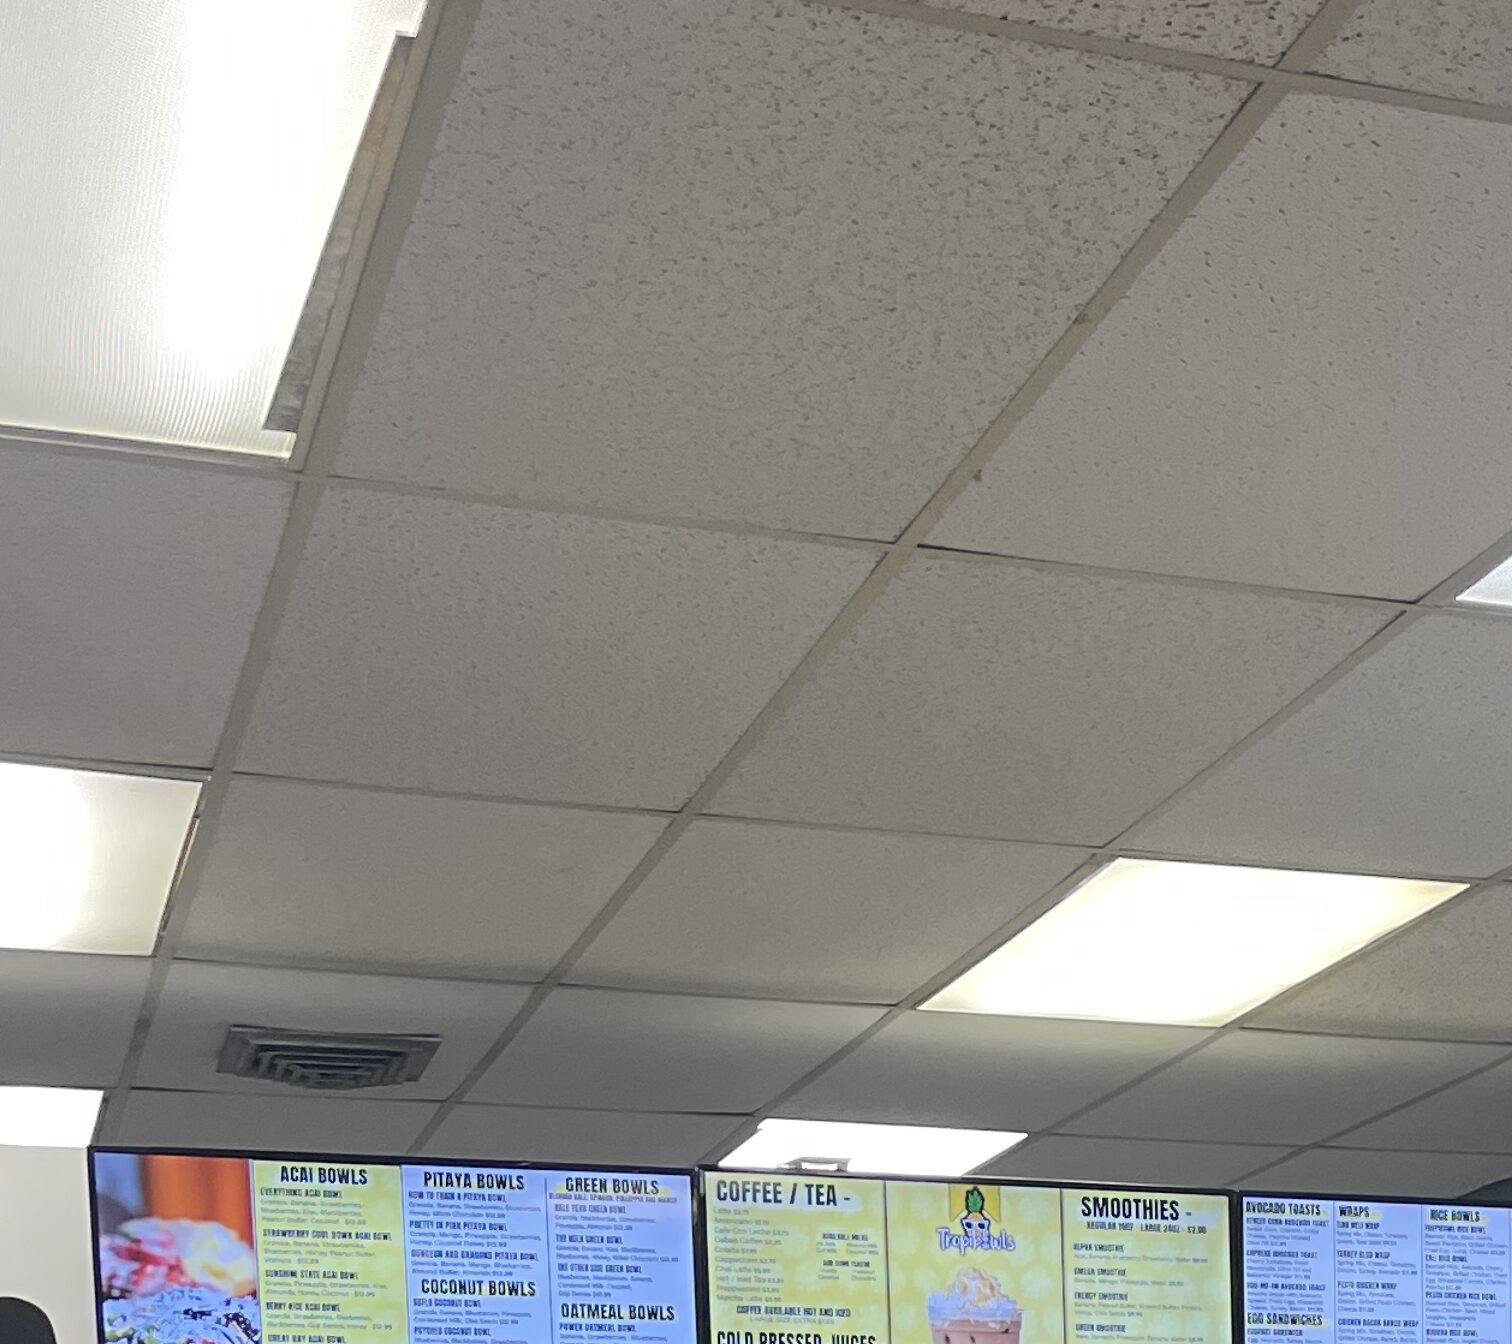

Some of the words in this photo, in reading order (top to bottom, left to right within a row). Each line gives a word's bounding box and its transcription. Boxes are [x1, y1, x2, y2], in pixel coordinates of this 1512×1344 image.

[281, 1166, 313, 1183] ACAI
[318, 1169, 368, 1185] BOWLS
[424, 1171, 472, 1188] PITAYA
[476, 1174, 524, 1190] BOWLS
[566, 1177, 607, 1193] GREEN
[612, 1179, 659, 1194] BOWLS
[717, 1180, 782, 1203] COFFEE
[789, 1183, 797, 1204] /
[805, 1184, 837, 1206] TEA
[1081, 1196, 1179, 1221] SMOOTHIES
[1246, 1202, 1285, 1213] AVOCADO
[1289, 1204, 1320, 1215] TOASTS
[1339, 1206, 1369, 1217] WRAPS
[1430, 1209, 1447, 1221] RICE
[1451, 1211, 1480, 1222] BOWLS
[422, 1279, 483, 1295] COCONUT
[489, 1280, 536, 1296] BOWLS
[561, 1303, 623, 1319] OATMEAL
[629, 1305, 674, 1320] BOWLS
[1247, 1313, 1263, 1324] EGG
[1267, 1313, 1322, 1325] SANDWICHES
